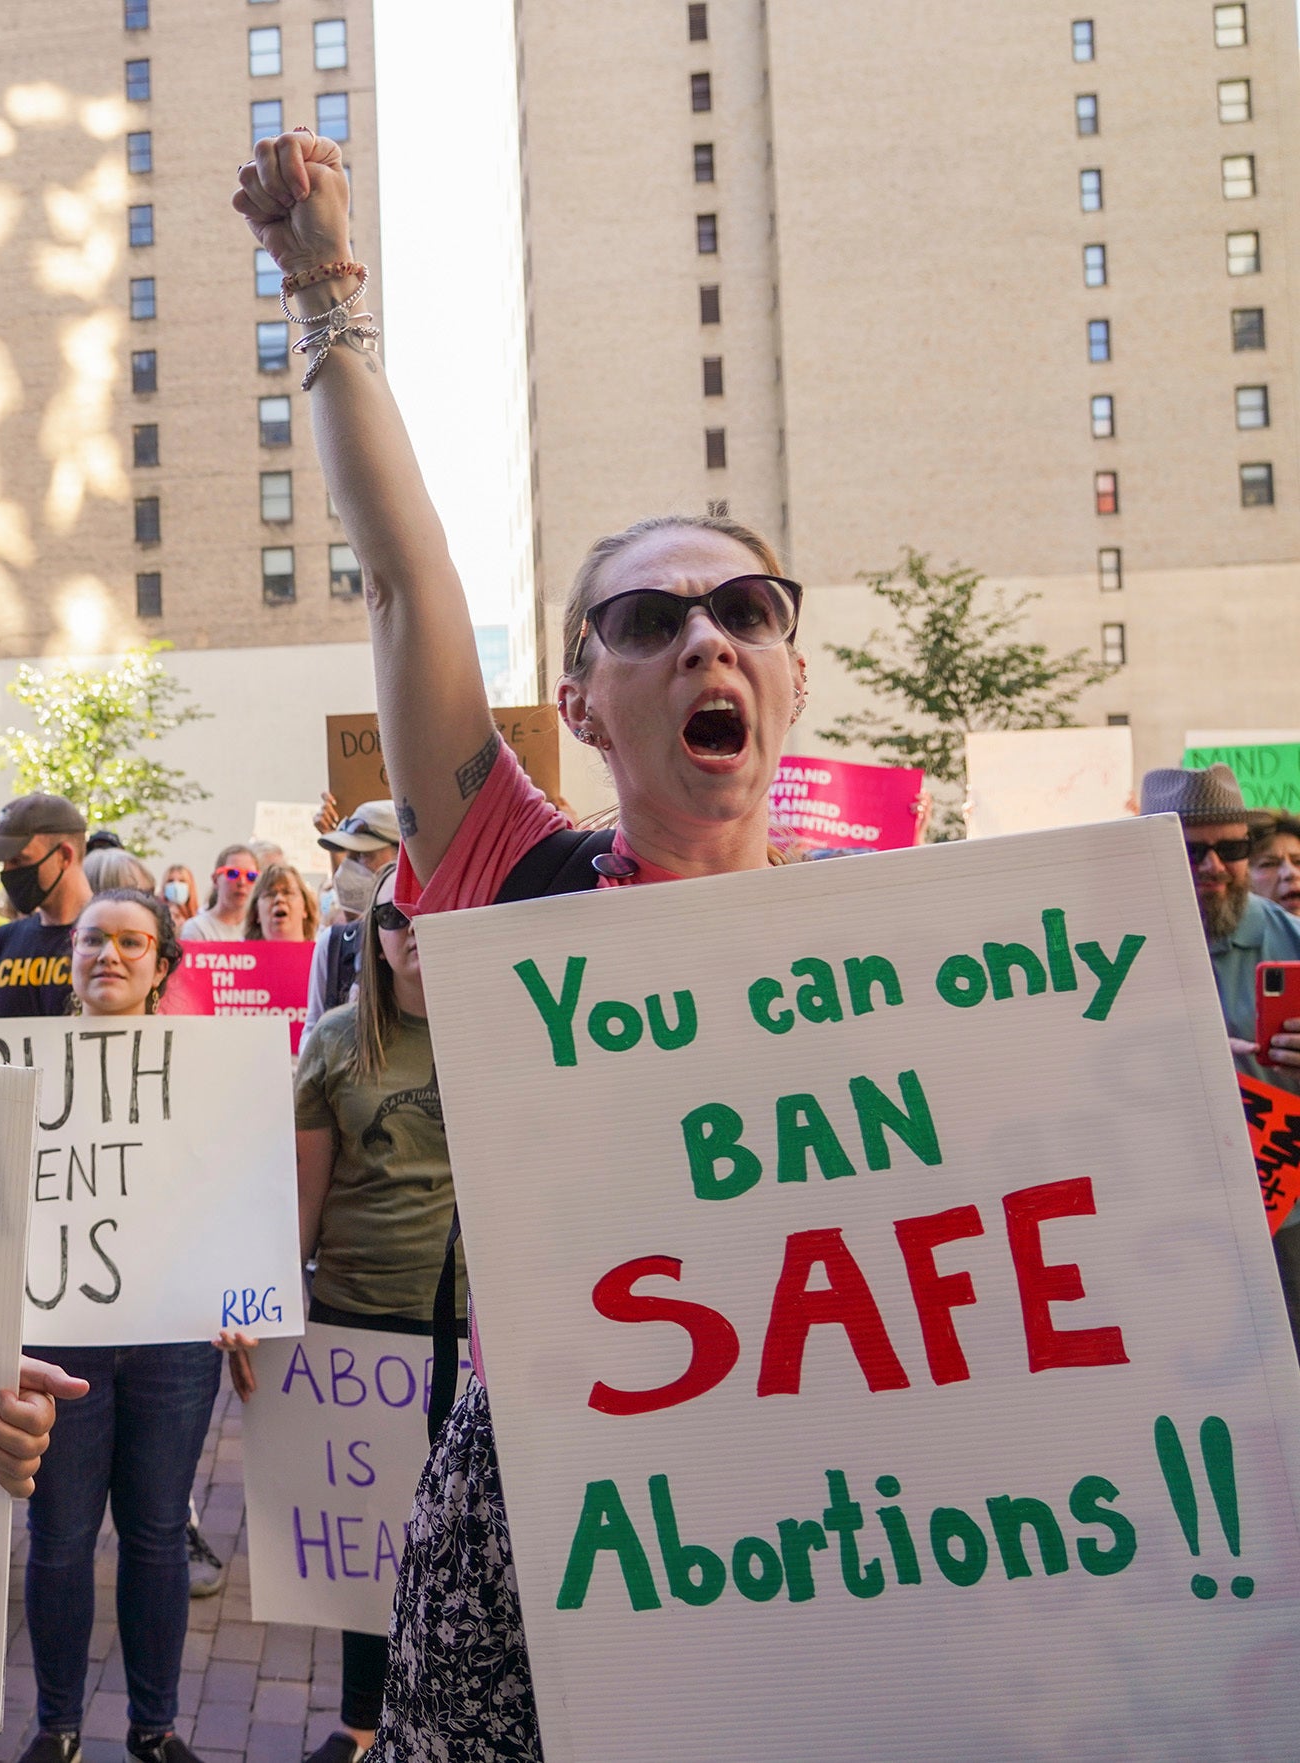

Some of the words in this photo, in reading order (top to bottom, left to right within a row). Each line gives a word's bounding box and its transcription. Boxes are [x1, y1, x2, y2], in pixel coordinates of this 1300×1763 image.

[195, 953, 257, 970] STAND
[513, 955, 699, 1068] You
[748, 954, 905, 1036] can
[935, 908, 1147, 1021] only
[381, 1093, 406, 1115] SAN
[681, 1069, 943, 1201] BAN
[35, 1142, 143, 1202] ENT
[25, 1219, 122, 1310] US
[588, 1176, 1131, 1416] SAFE
[221, 1287, 282, 1328] RBG
[326, 1440, 376, 1487] IS
[293, 1506, 410, 1582] HEA
